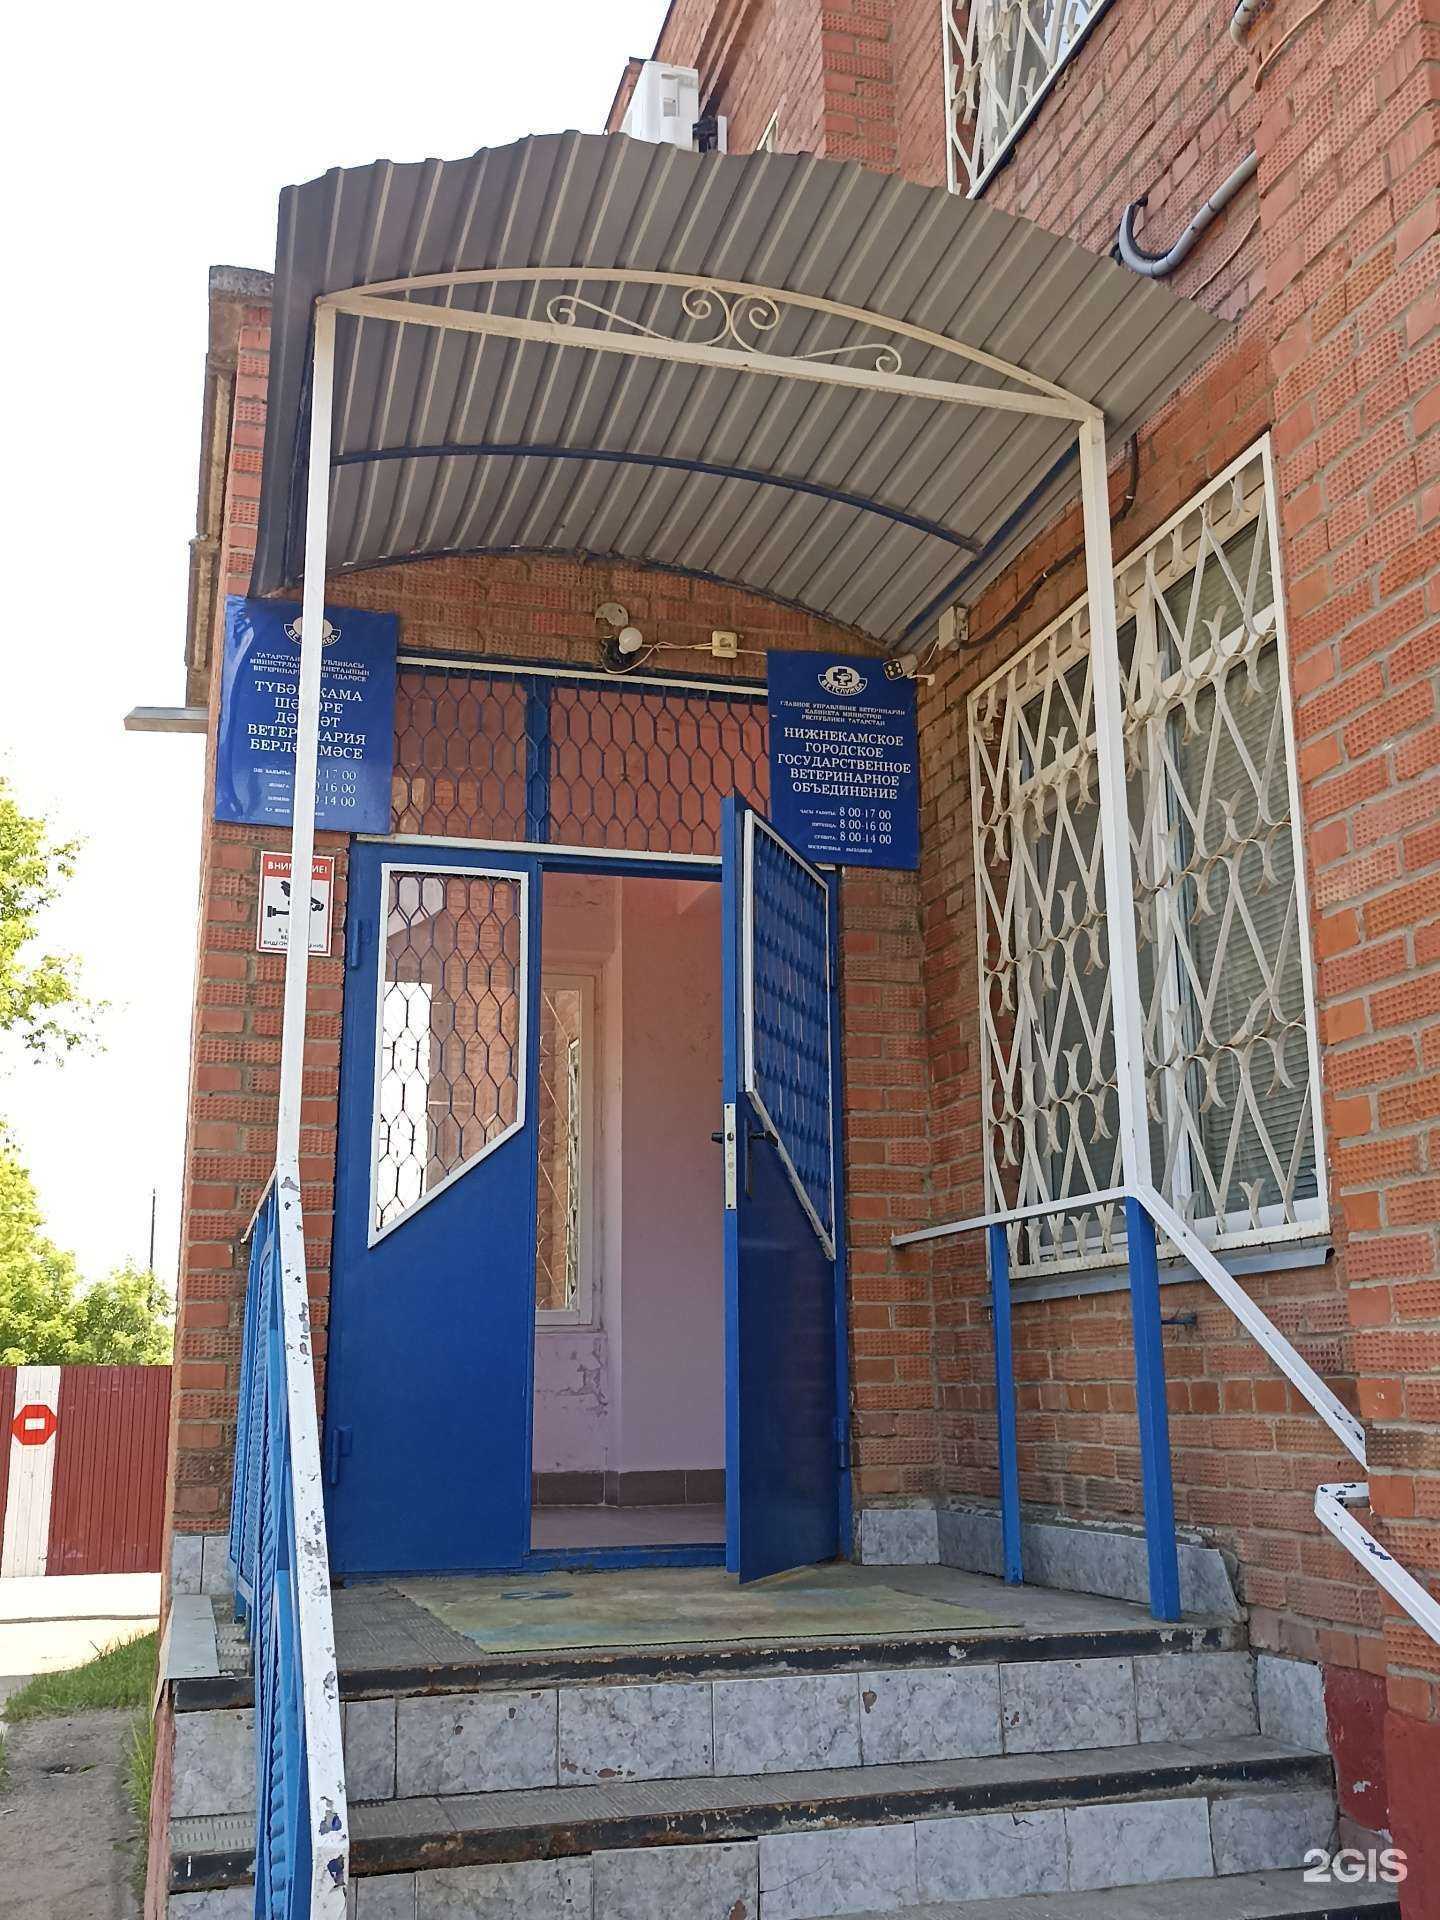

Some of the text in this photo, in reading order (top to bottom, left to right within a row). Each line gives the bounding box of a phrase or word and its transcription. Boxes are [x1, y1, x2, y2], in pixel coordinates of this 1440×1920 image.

[255, 680, 299, 695] ТҮБӘ
[783, 727, 904, 747] НИЖНЕКАМСКОЕ
[805, 742, 884, 758] ГОРОДСКОЕ
[777, 753, 912, 774] ГОСУДАРСТВЕННОЕ
[790, 768, 900, 786] ВЕТЕРИНАРНОЕ
[792, 782, 898, 800] ОБЪЕДИНЕНИЕ
